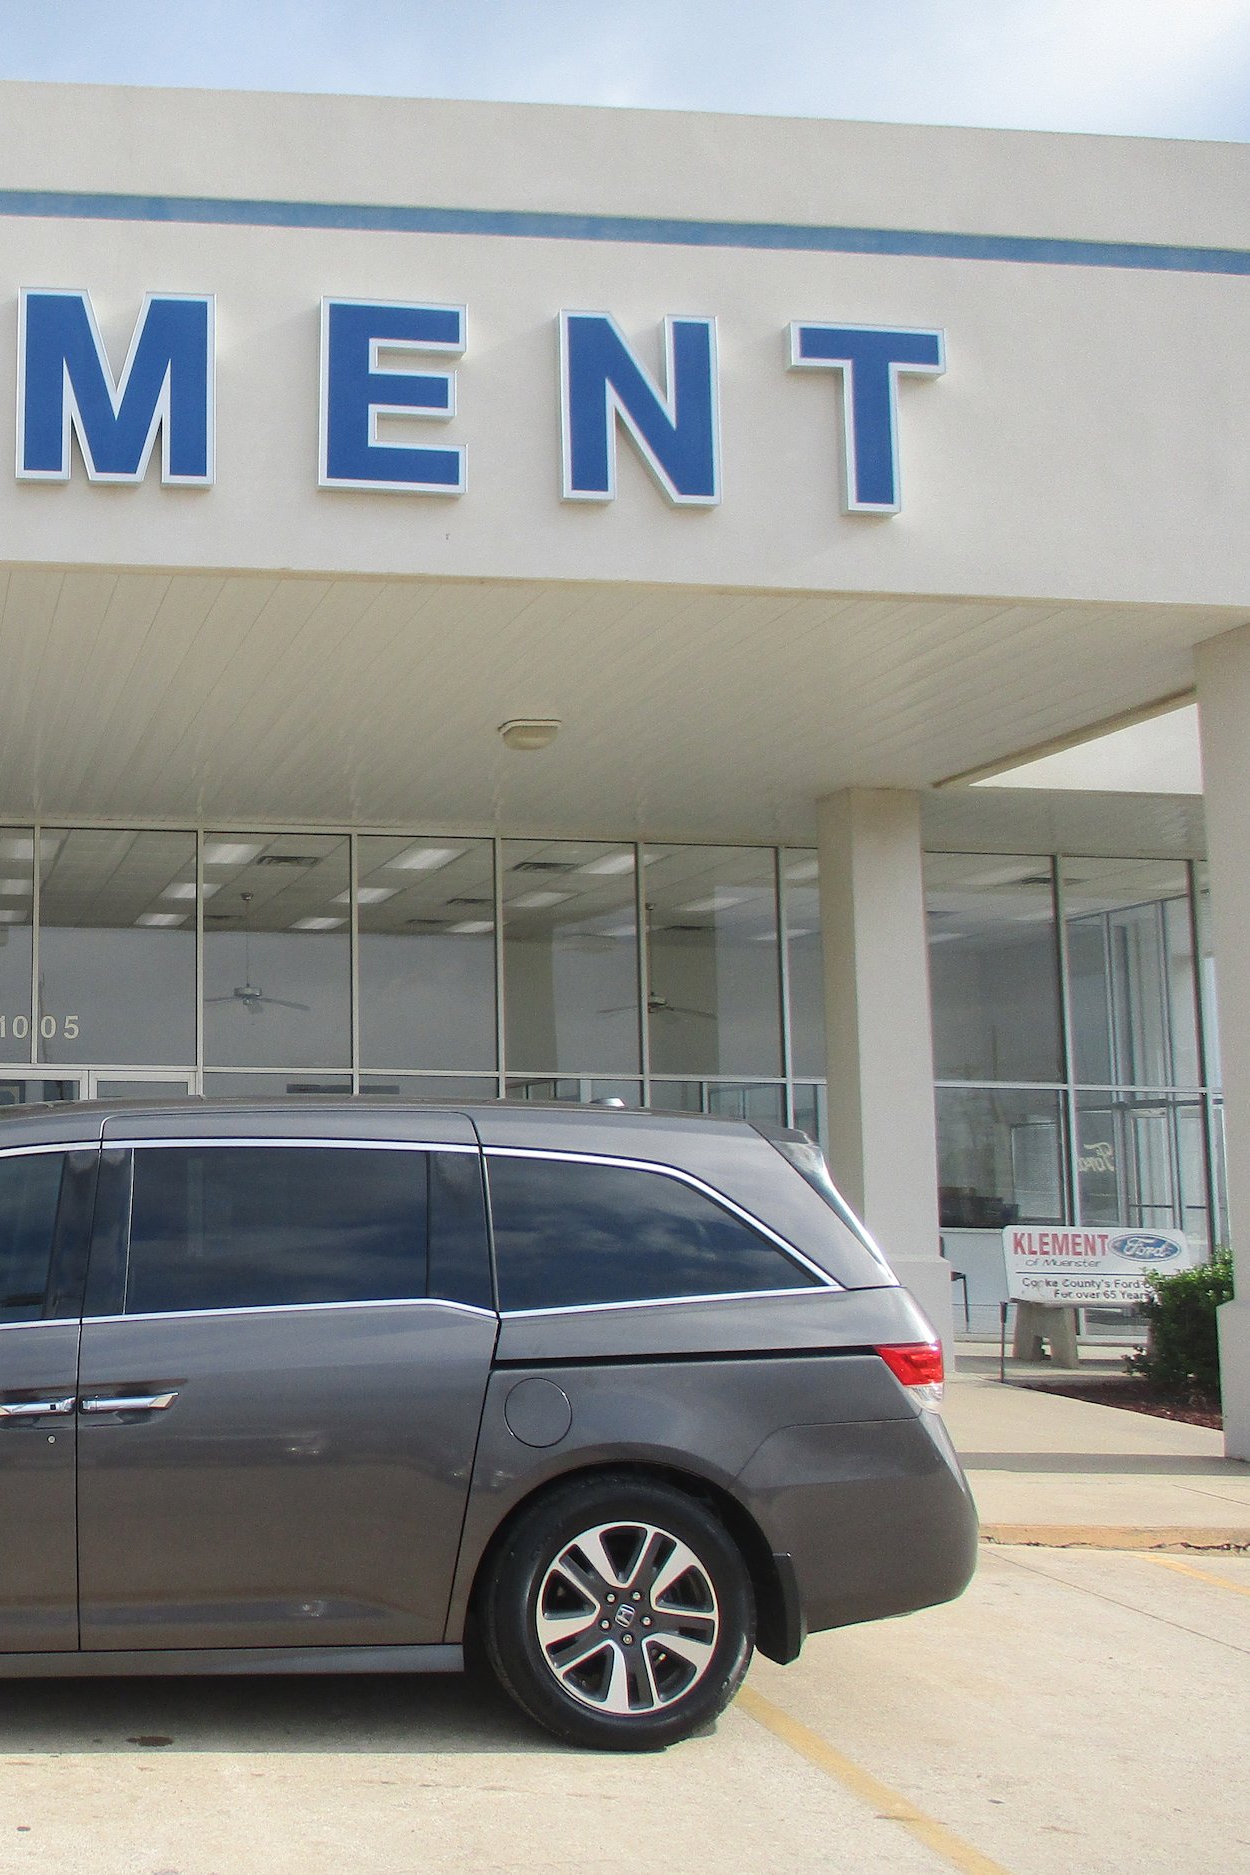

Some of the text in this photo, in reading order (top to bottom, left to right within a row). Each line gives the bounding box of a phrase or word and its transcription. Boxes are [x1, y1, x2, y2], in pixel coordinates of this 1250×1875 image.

[1012, 1232, 1109, 1257] KLEMENT
[1124, 1237, 1171, 1258] Ford
[1025, 1257, 1101, 1268] of Muenster
[1062, 1278, 1111, 1291] County's
[1114, 1279, 1141, 1289] Ford
[1054, 1289, 1073, 1299] For
[1076, 1290, 1101, 1299] over
[1103, 1290, 1117, 1299] 65
